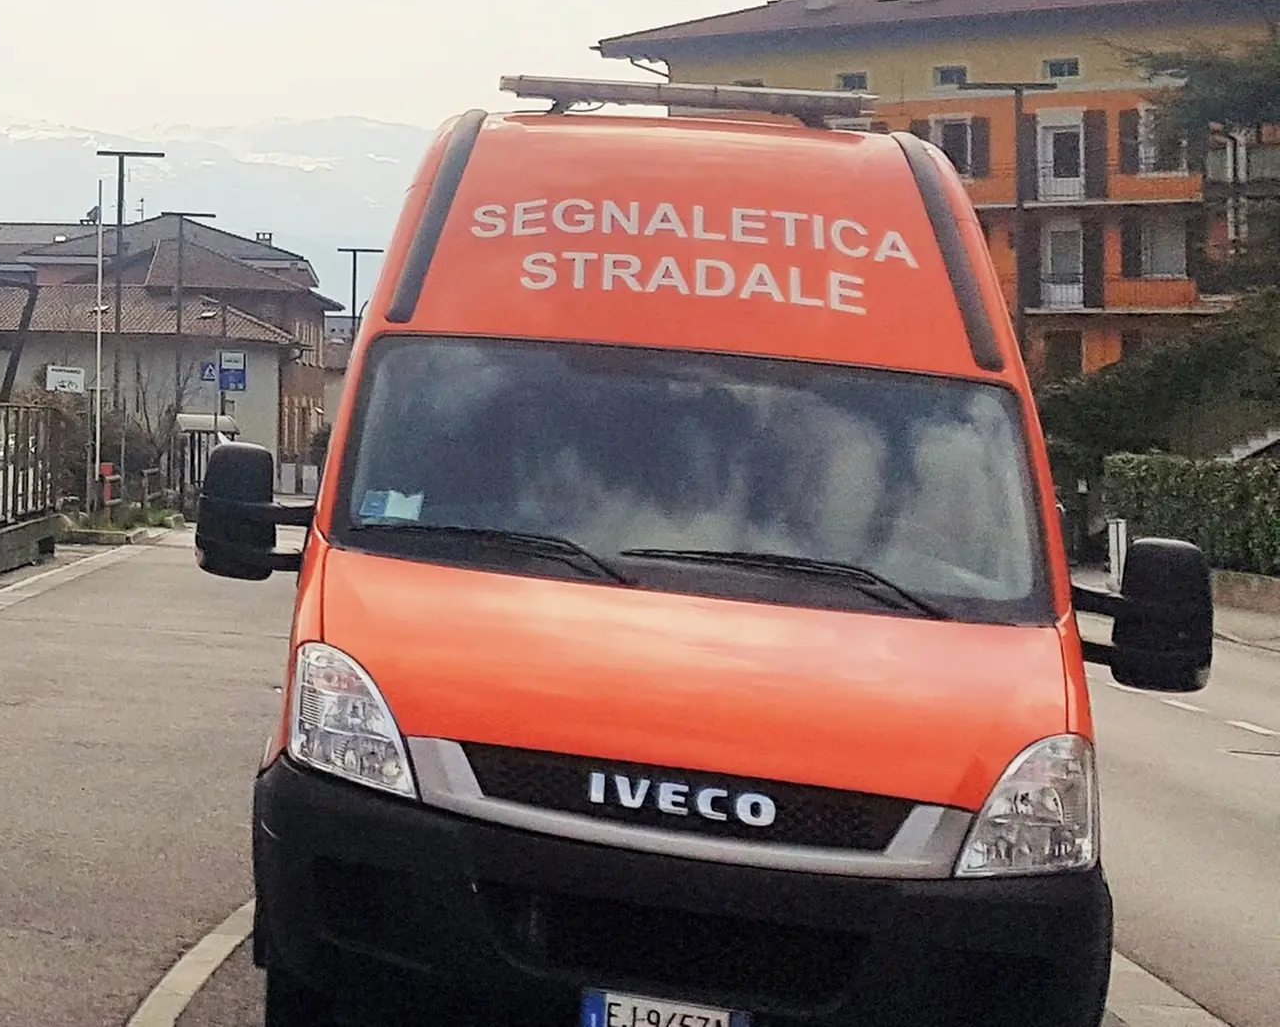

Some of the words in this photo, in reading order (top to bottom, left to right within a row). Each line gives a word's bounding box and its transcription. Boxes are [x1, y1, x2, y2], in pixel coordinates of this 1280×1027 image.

[470, 198, 919, 269] SEGNALETICA
[520, 251, 867, 315] STRADALE
[590, 772, 777, 827] IVECO
